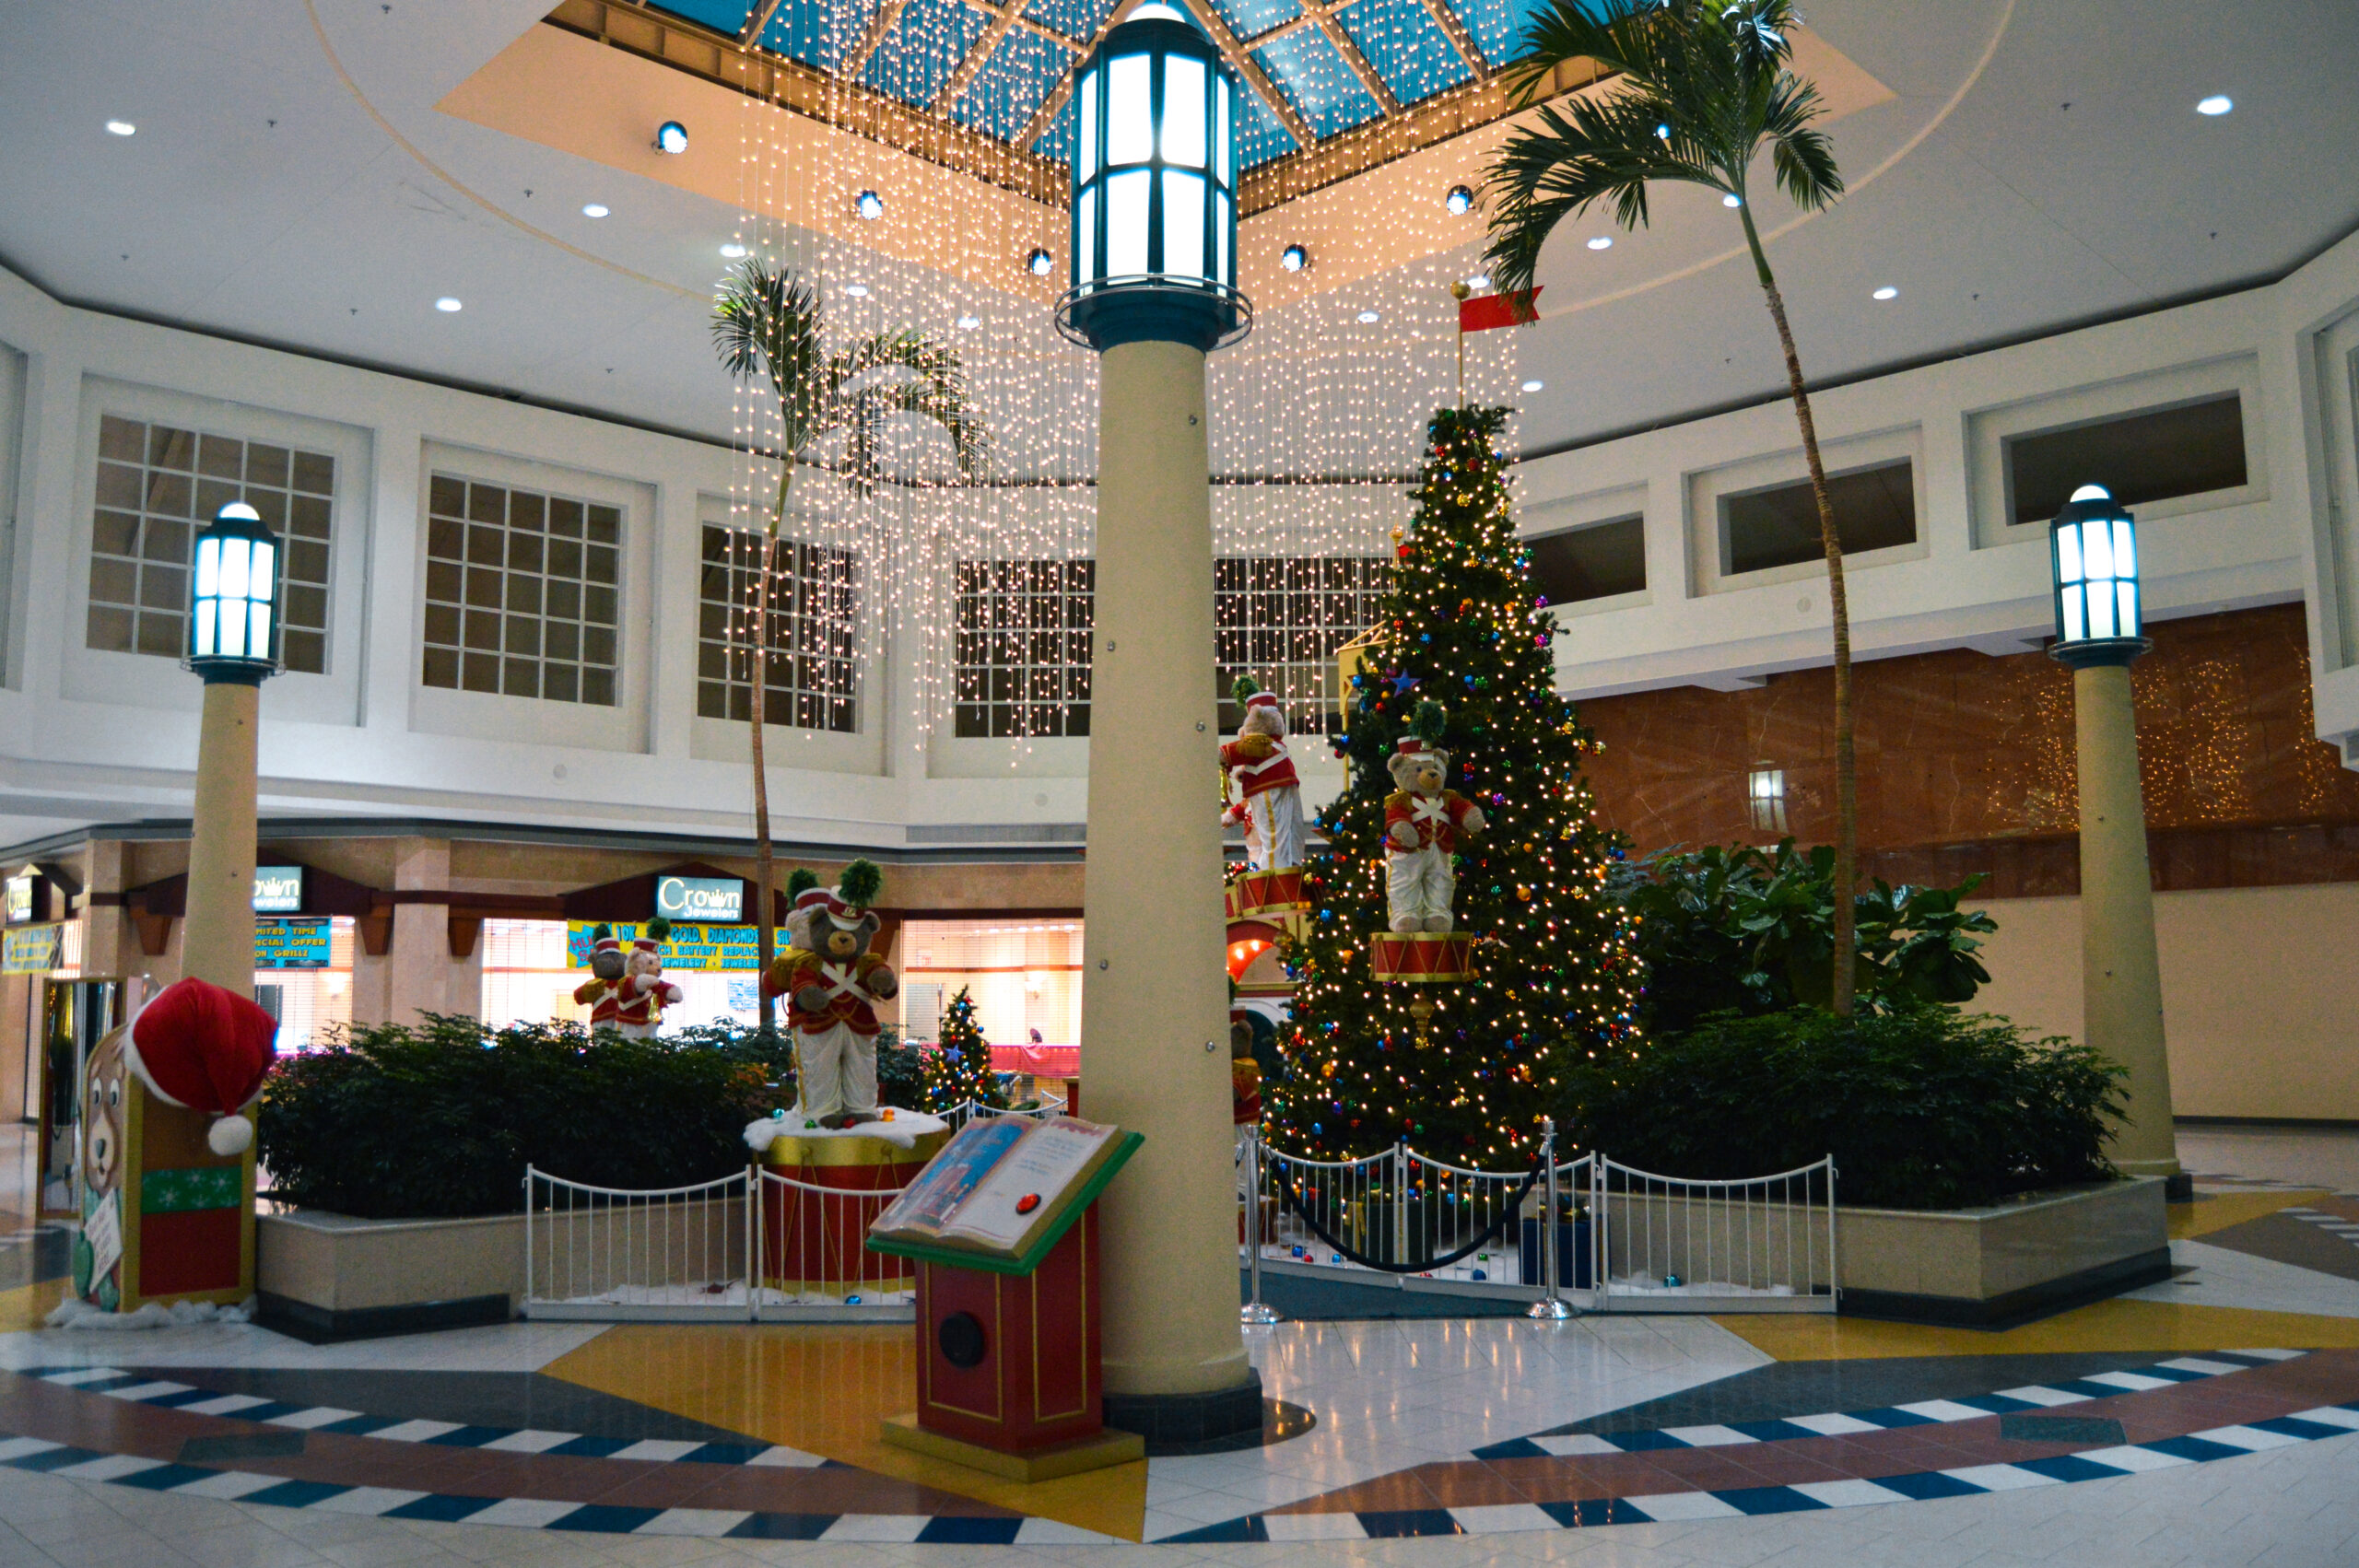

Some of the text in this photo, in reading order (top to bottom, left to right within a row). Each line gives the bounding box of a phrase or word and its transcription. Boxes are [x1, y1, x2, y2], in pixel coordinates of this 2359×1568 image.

[254, 877, 299, 896] own
[659, 878, 741, 910] Crown
[684, 905, 739, 919] Jewelers
[255, 927, 317, 936] MITED TIME
[670, 927, 703, 943] GOLD,
[290, 938, 326, 946] OFFER
[274, 949, 309, 958] GRILLZ
[677, 945, 717, 955] BATTERY
[722, 958, 759, 968] JEWELER
